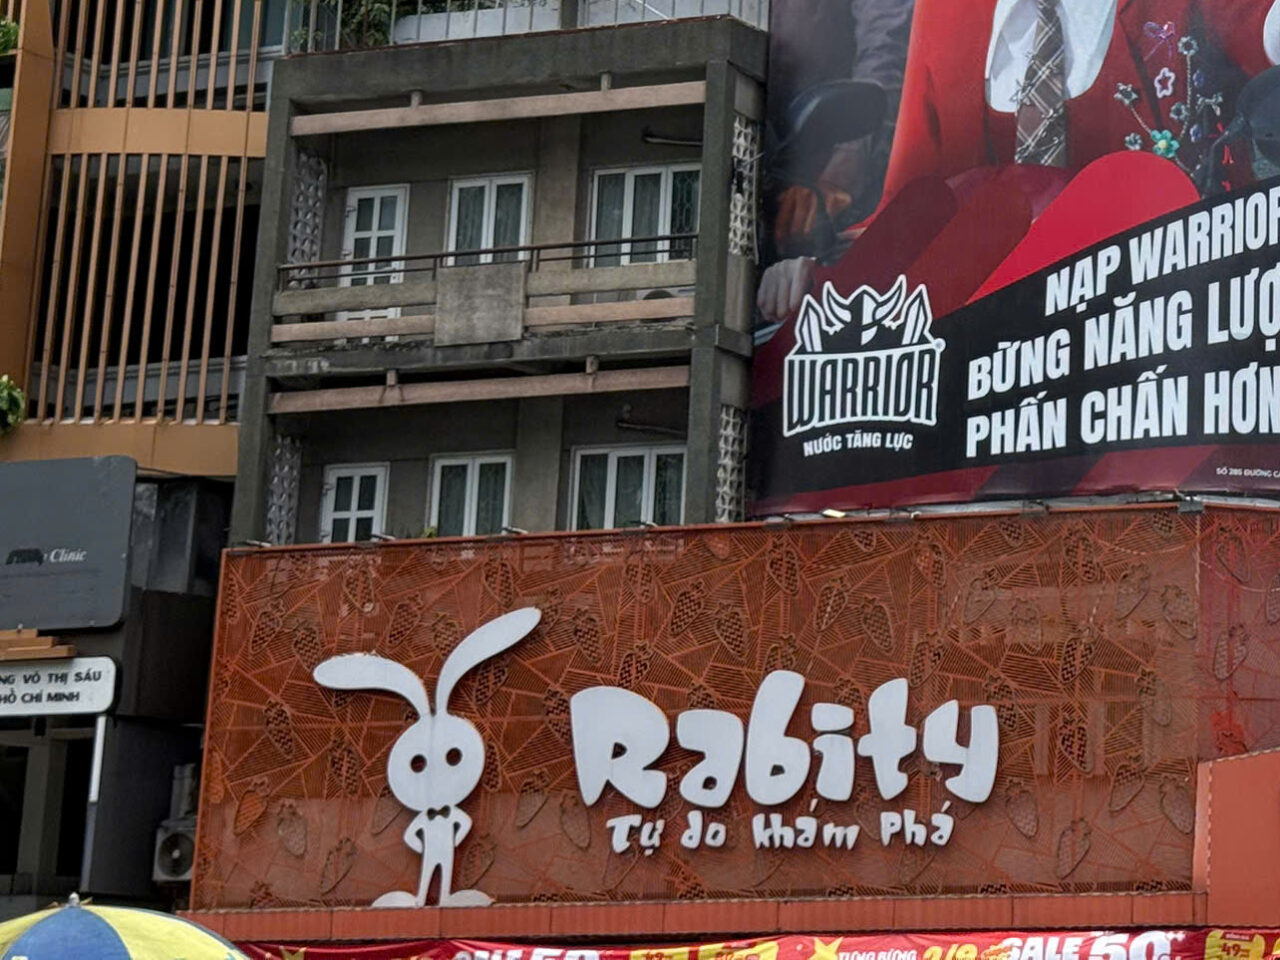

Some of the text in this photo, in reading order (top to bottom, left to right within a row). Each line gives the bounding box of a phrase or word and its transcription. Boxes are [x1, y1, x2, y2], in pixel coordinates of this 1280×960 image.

[1044, 245, 1122, 317] NẠP
[968, 328, 1071, 401] BỪNG
[1084, 290, 1193, 370] NĂNG
[784, 345, 938, 436] WARRIOR
[966, 390, 1067, 458] PHẤN
[1080, 364, 1189, 446] CHẤN
[803, 428, 914, 457] NƯỚC TĂNG LỰC
[50, 548, 87, 563] Clinic
[21, 689, 43, 703] CHÍ
[46, 691, 80, 703] MINH
[570, 670, 999, 809] Rabity
[606, 798, 954, 856] Tự do khám Phá
